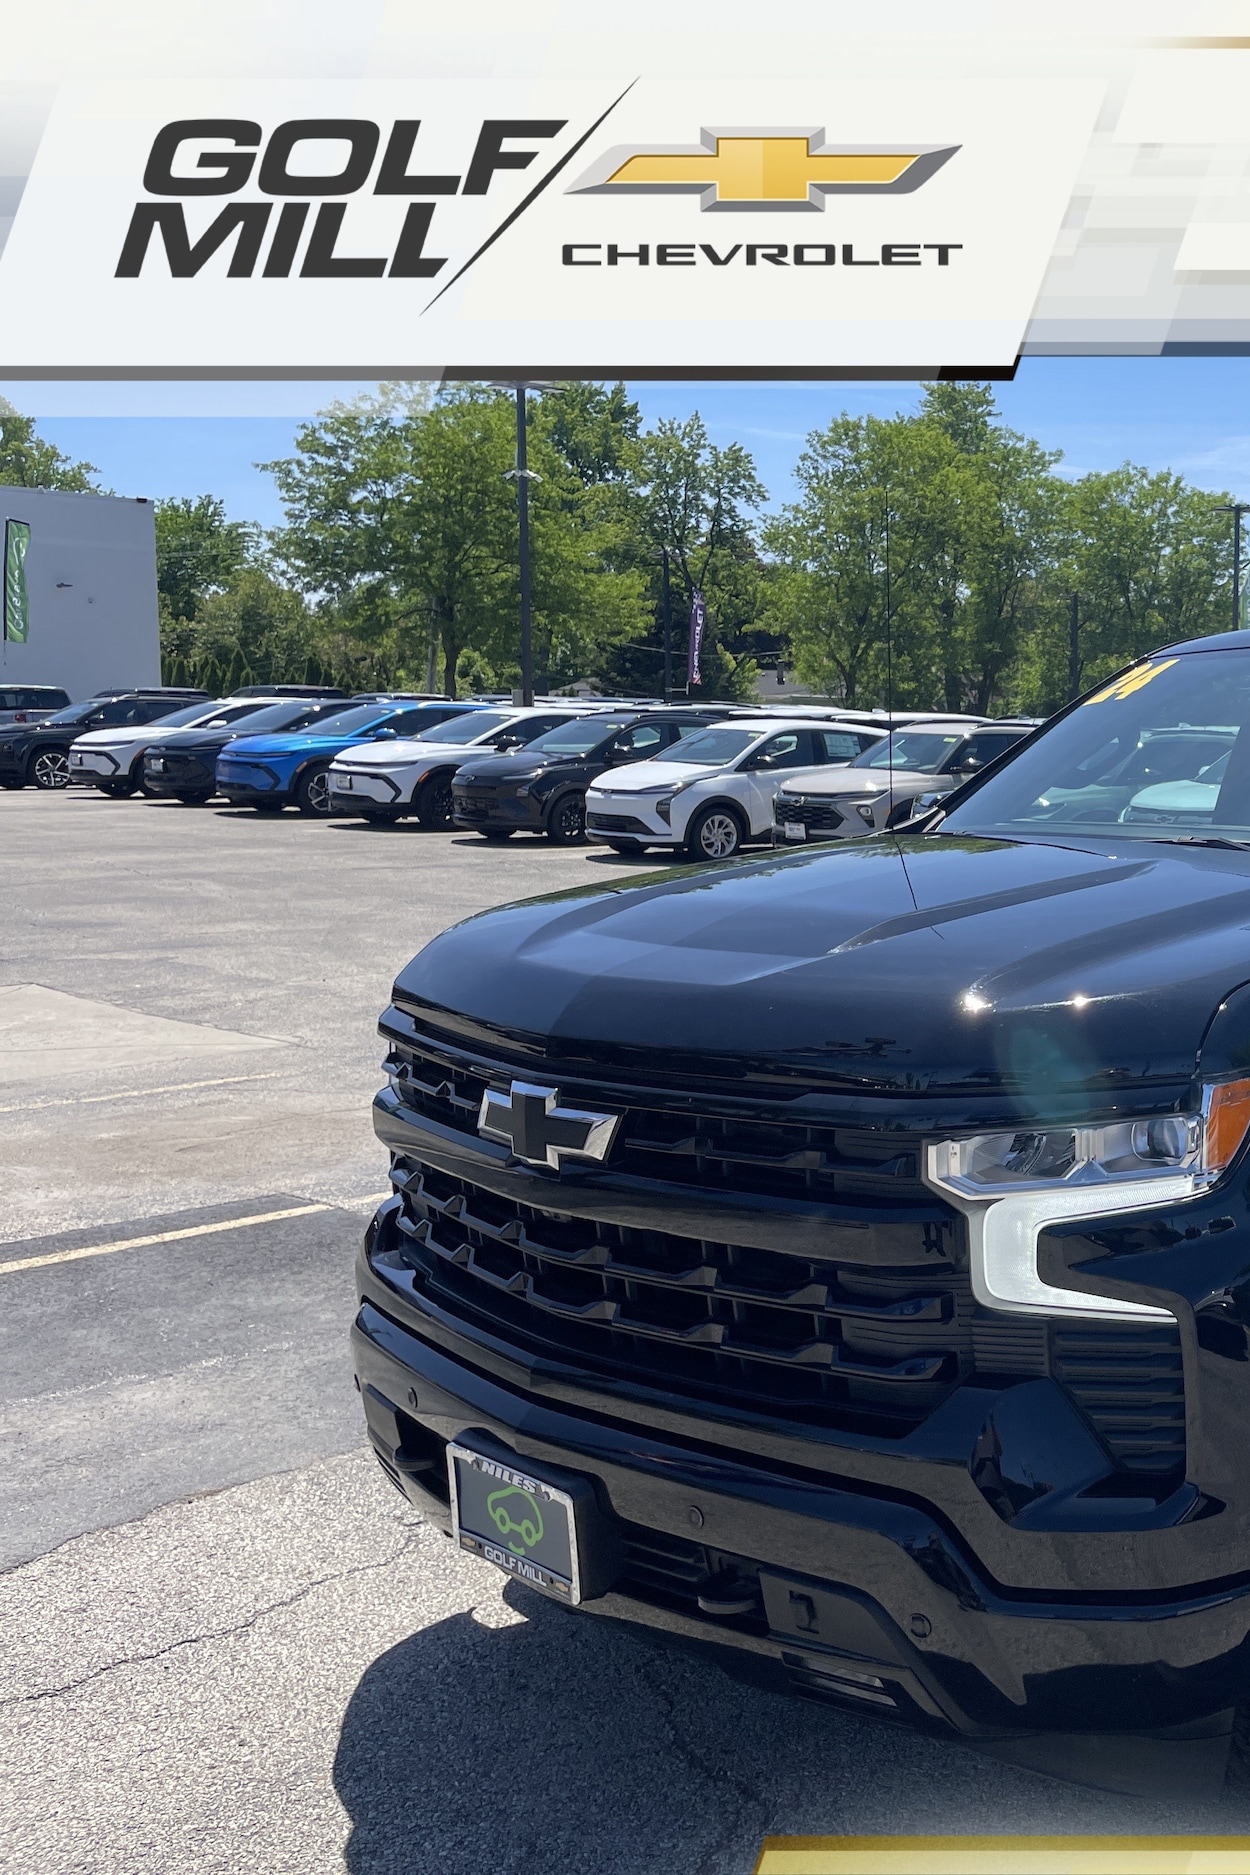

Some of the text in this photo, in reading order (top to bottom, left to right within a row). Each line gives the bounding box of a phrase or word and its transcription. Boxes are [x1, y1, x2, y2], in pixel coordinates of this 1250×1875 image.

[481, 1461, 537, 1494] NILES
[484, 1545, 547, 1587] GOLF MILL
